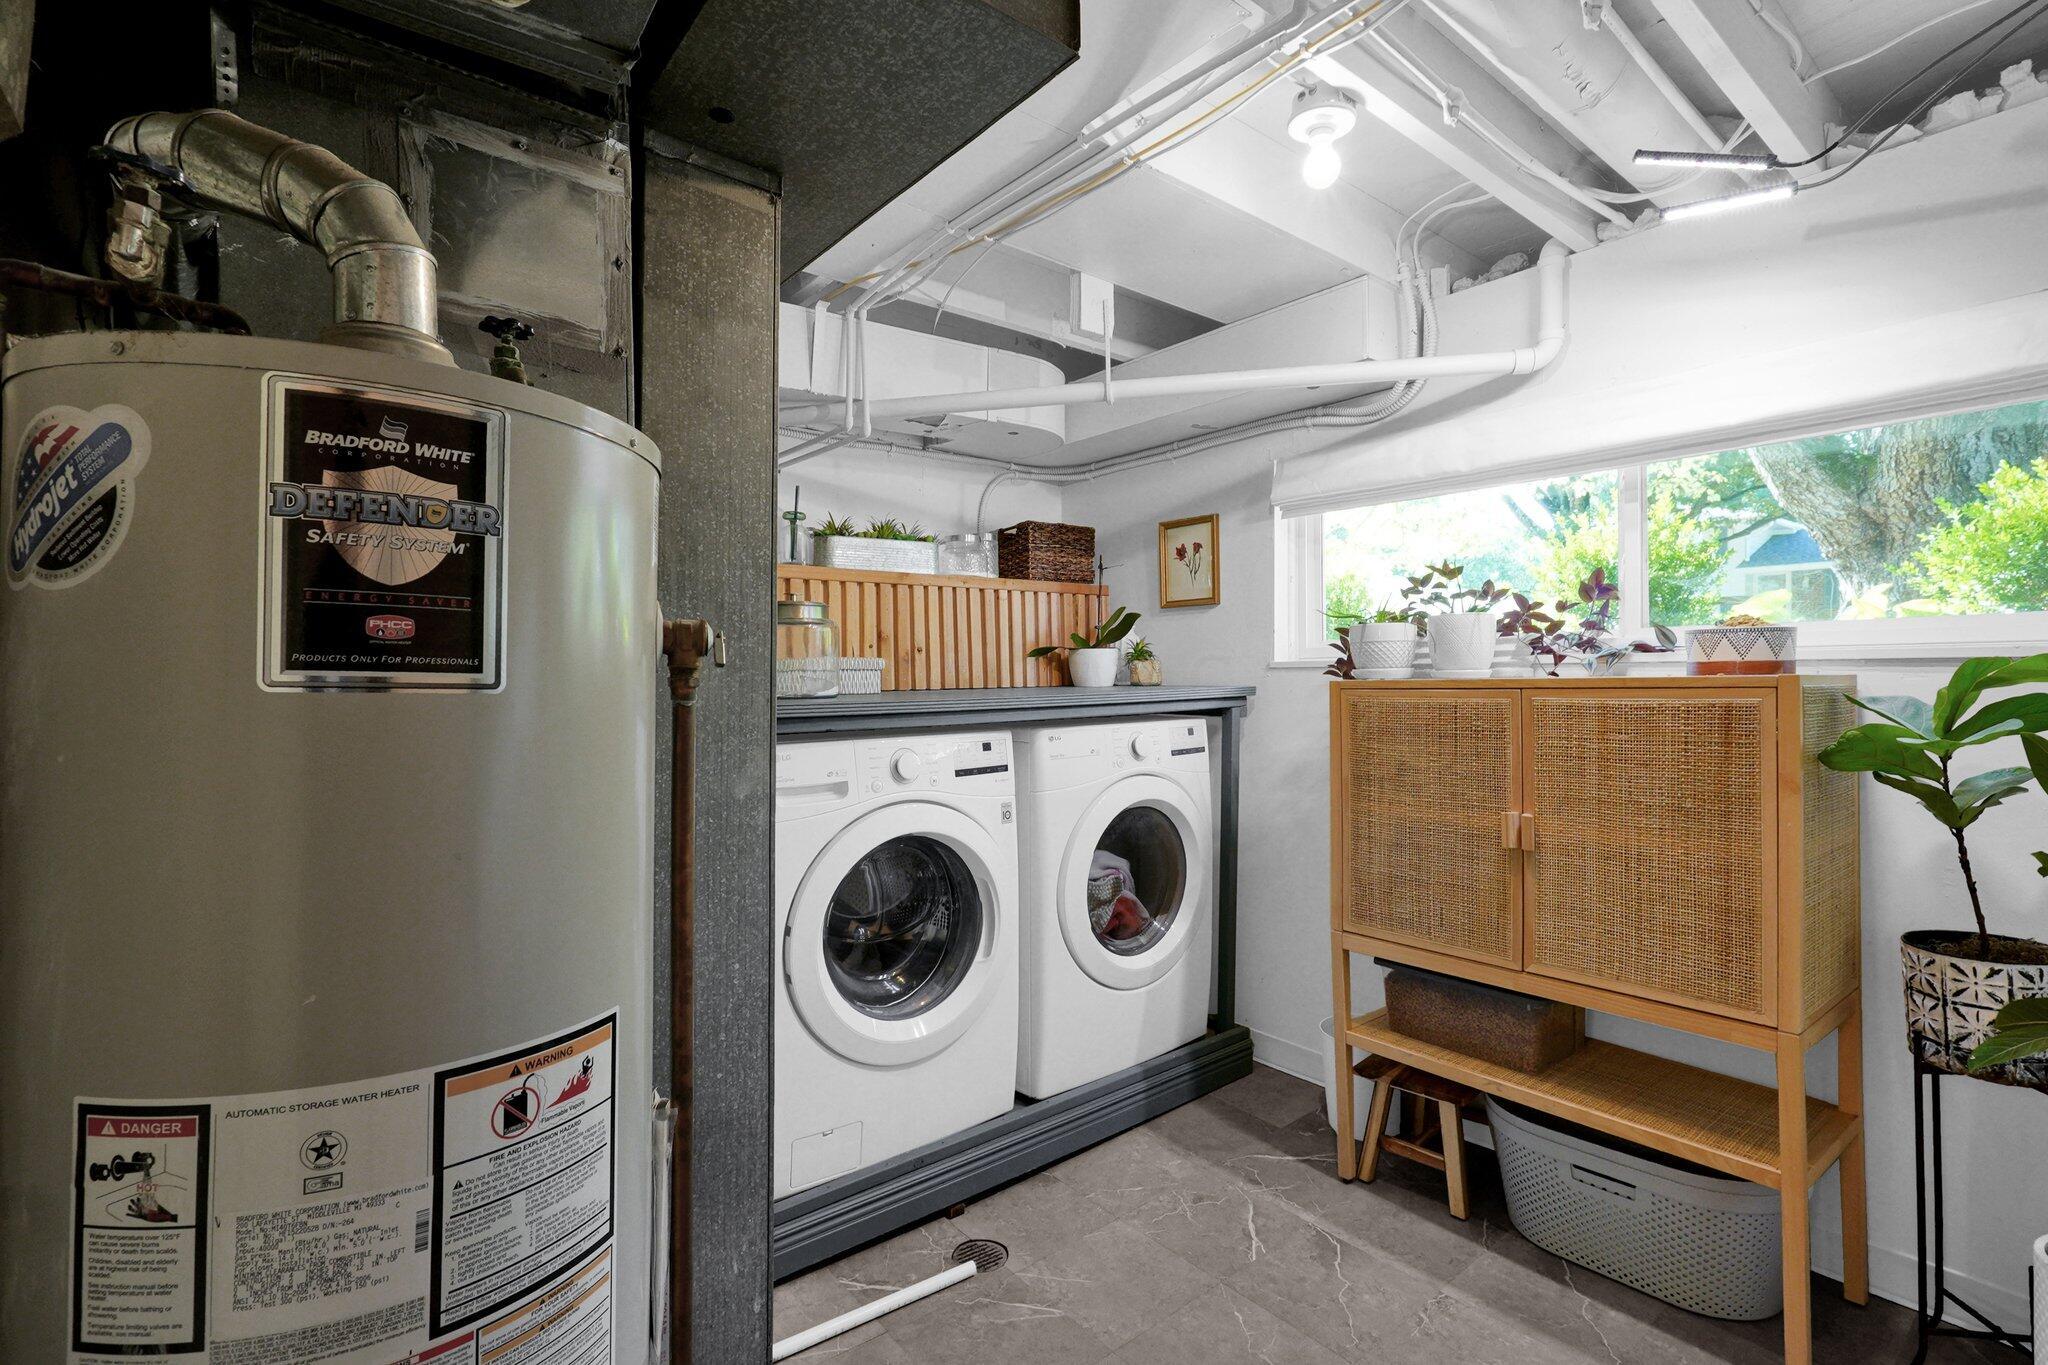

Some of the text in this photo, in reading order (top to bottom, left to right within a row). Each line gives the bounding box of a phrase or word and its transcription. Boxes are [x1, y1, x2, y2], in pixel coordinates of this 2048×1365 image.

[74, 445, 92, 463] TOTAL
[78, 430, 122, 471] PERFORMANCE
[304, 430, 473, 464] BRADFORD WHITE
[318, 447, 460, 470] CORPORATION
[81, 456, 106, 481] SYSTEM
[14, 464, 78, 560] Hydrojet
[270, 482, 501, 536] DEFENDER
[306, 529, 468, 555] SAFETY SYSTEM
[304, 591, 472, 608] ENERGY SAVER
[369, 620, 412, 629] PHCC
[291, 653, 480, 666] PRODUCTS ONLY FOR PROFESSIONALS
[524, 1046, 574, 1072] WARNING
[225, 1084, 420, 1119] AUTOMATIC STORAGE WATER HEATER
[541, 1100, 585, 1123] Flammable Vapors
[121, 1123, 181, 1134] DANGER
[489, 1152, 504, 1163] FIRE
[506, 1145, 521, 1157] AND
[523, 1129, 558, 1151] EXPLOSION
[560, 1118, 581, 1134] HAZARD
